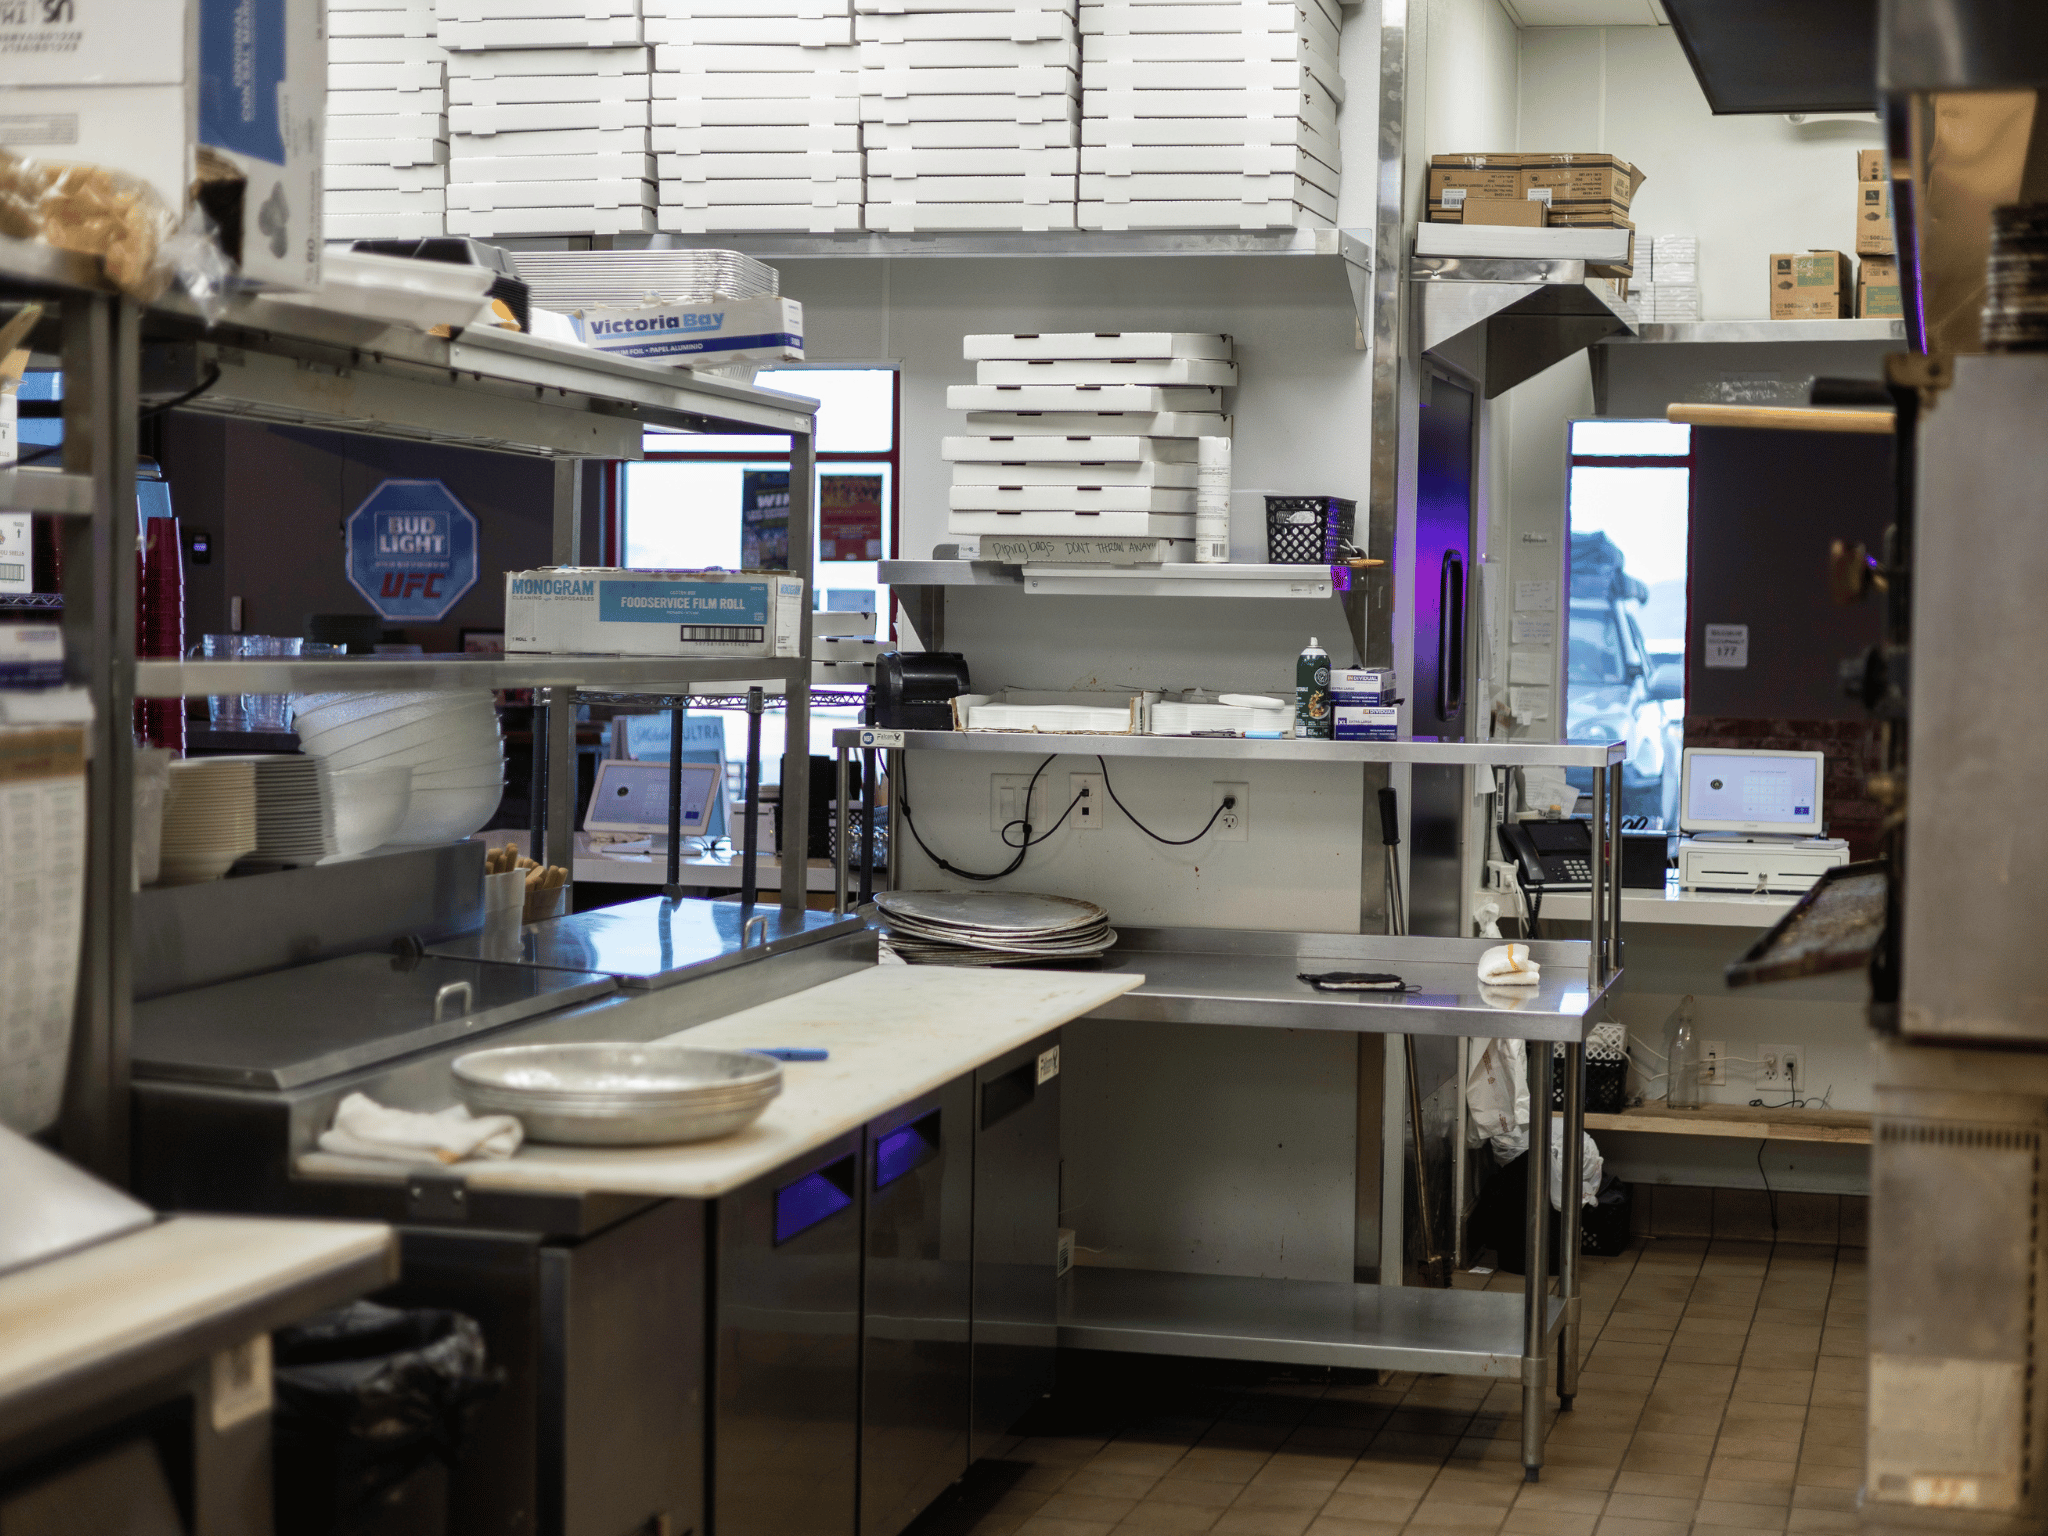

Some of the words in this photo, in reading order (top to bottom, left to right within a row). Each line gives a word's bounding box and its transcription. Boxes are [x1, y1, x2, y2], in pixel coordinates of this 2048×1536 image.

[590, 315, 680, 335] Victoria
[683, 312, 725, 331] Bay
[630, 347, 645, 355] FOIL
[649, 345, 669, 353] PAPEL
[670, 343, 704, 351] ALUMINIO
[388, 516, 436, 535] BUD
[380, 535, 444, 553] LIGHT
[1028, 540, 1055, 557] bags
[380, 572, 445, 598] UFC
[512, 578, 594, 595] MONOGRAM
[621, 596, 690, 608] FOODSERVICE
[692, 598, 717, 609] FILM
[719, 598, 746, 610] ROLL
[1717, 646, 1737, 656] 177
[876, 733, 894, 741] Falcon
